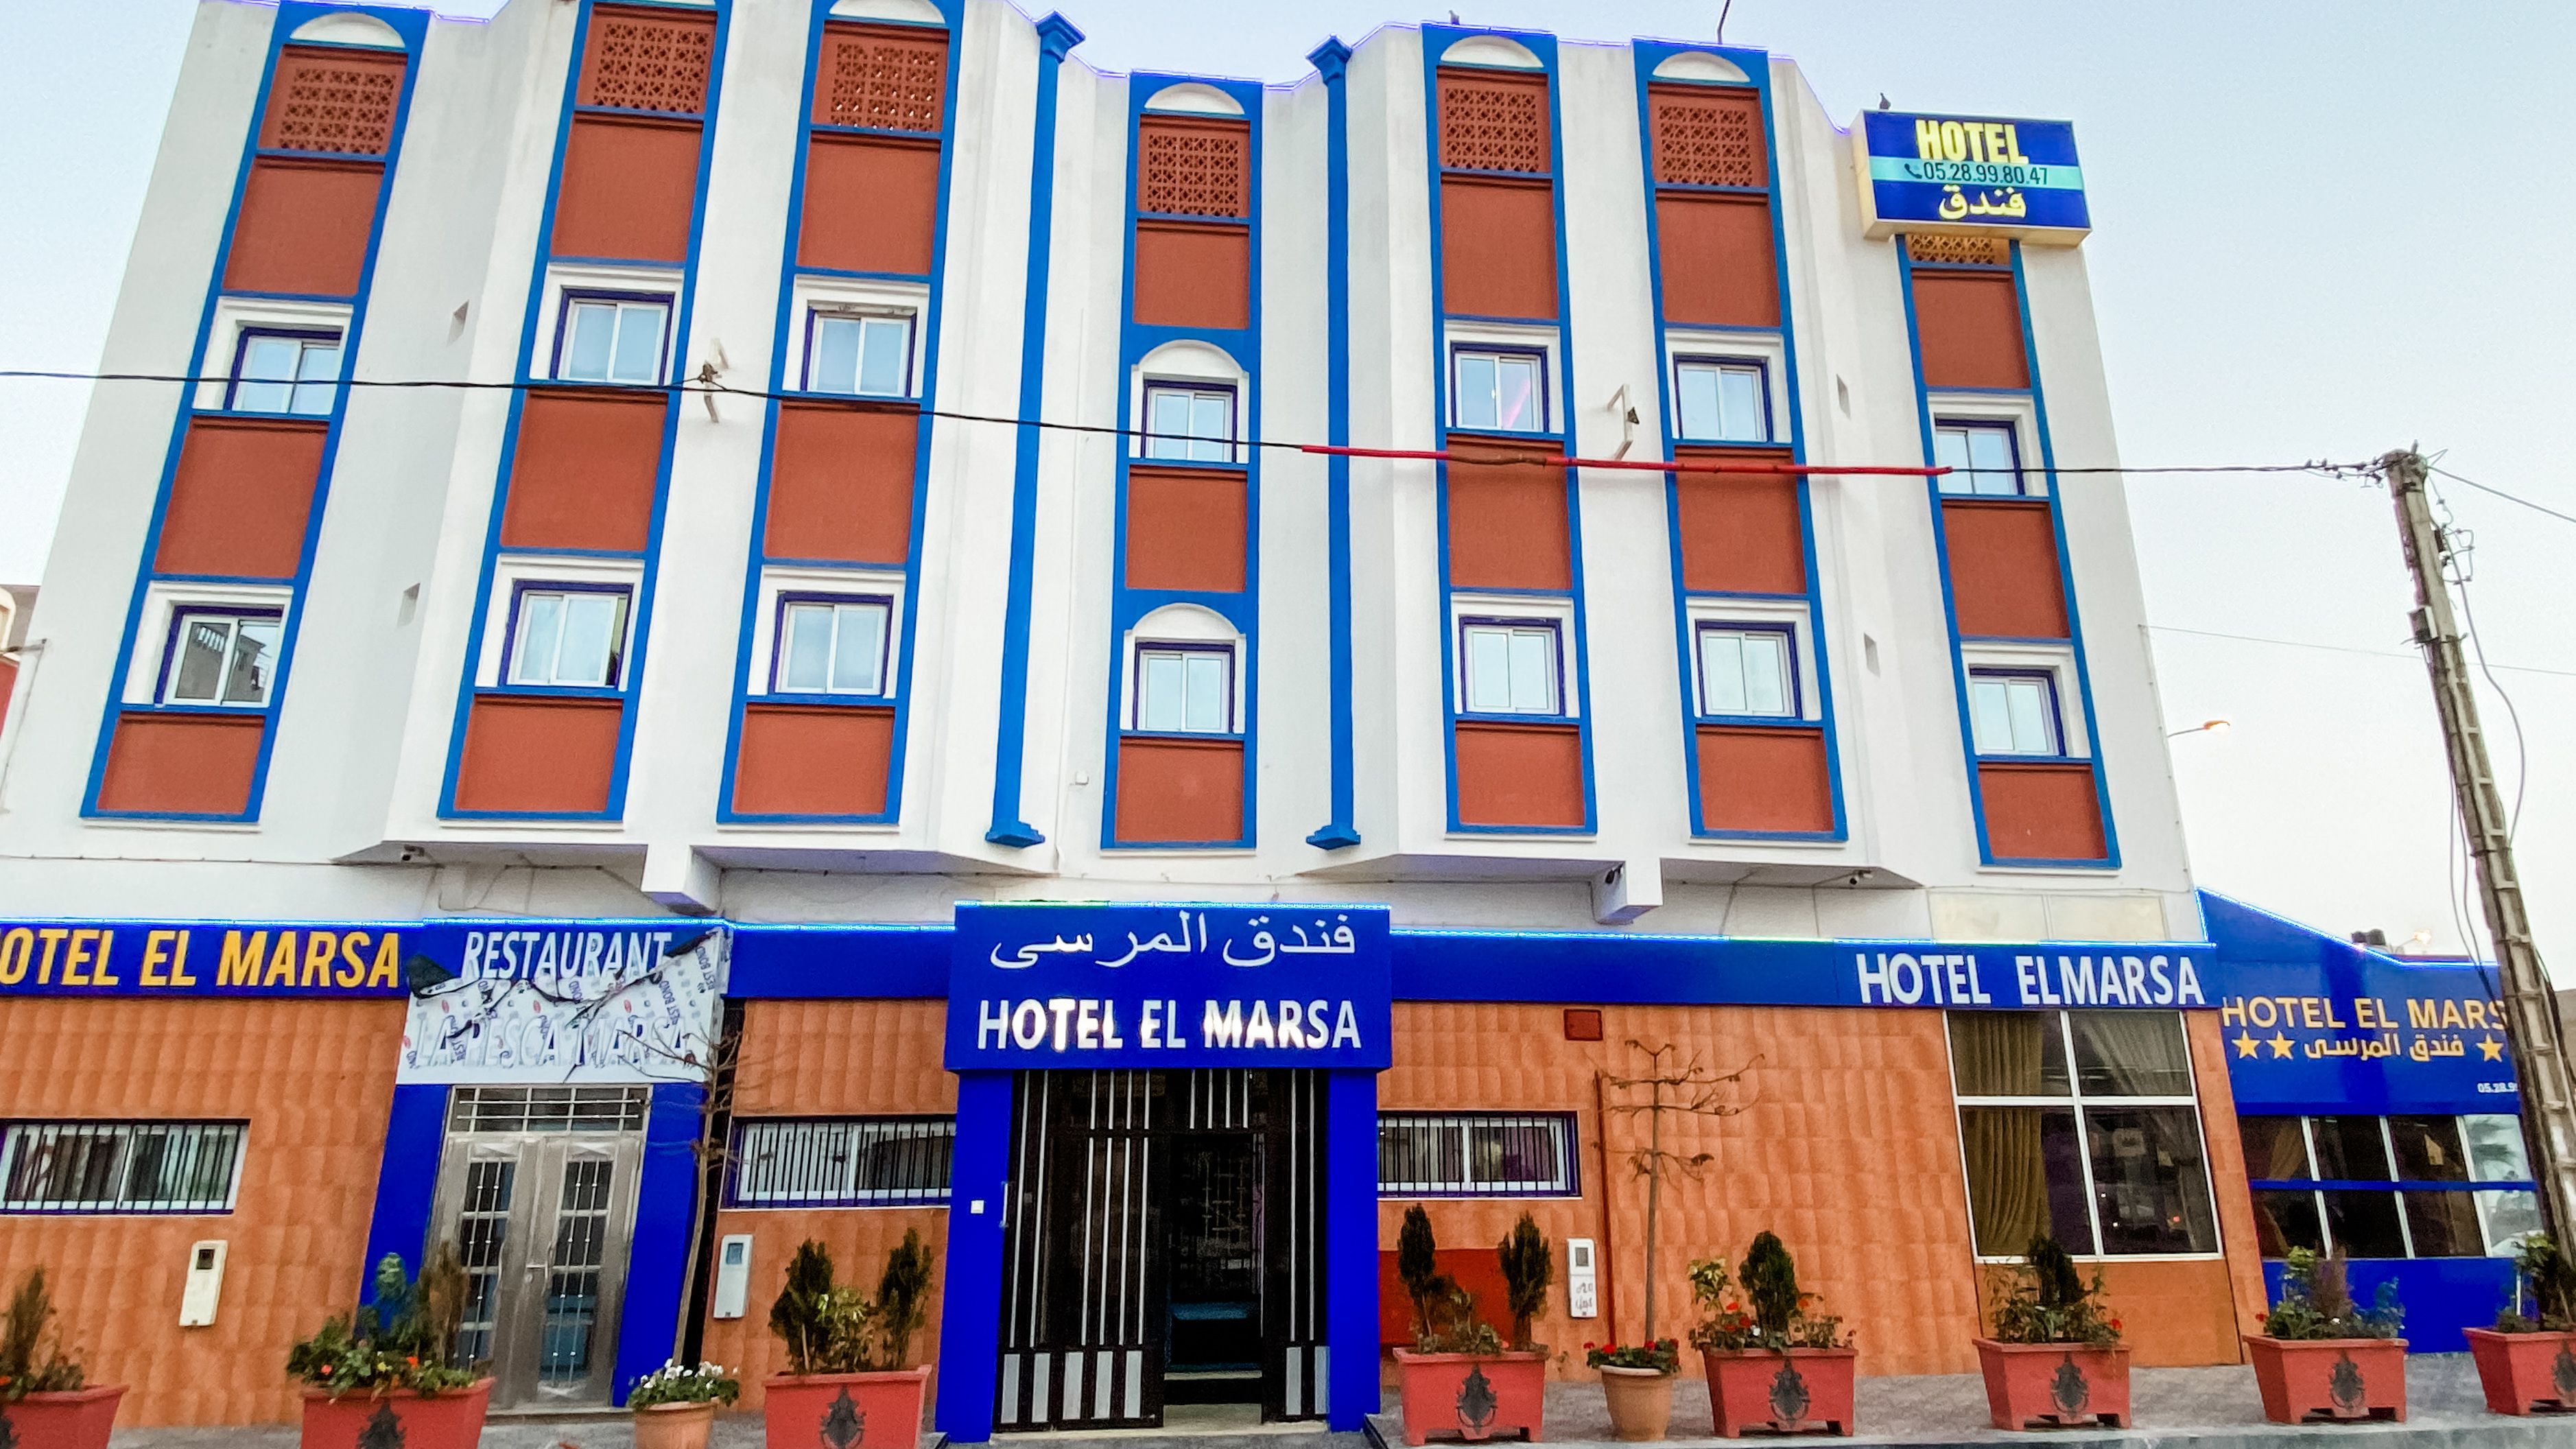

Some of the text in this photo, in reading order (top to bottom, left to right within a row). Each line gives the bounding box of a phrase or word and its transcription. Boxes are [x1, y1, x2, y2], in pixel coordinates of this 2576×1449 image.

[1915, 119, 2029, 165] HOTEL
[1924, 162, 2048, 185] 05.28.99.80.47
[1939, 184, 2026, 220] فندق
[0, 928, 399, 988] OTEL EL MARSA
[462, 931, 672, 980] RESTAURANT
[989, 910, 1356, 969] فندق المرسى
[1856, 953, 1991, 1005] HOTEL
[977, 998, 1362, 1052] HOTEL EL MARSA
[2221, 996, 2507, 1030] HOTEL EL MARS
[2304, 1033, 2465, 1062] فندق المرسى
